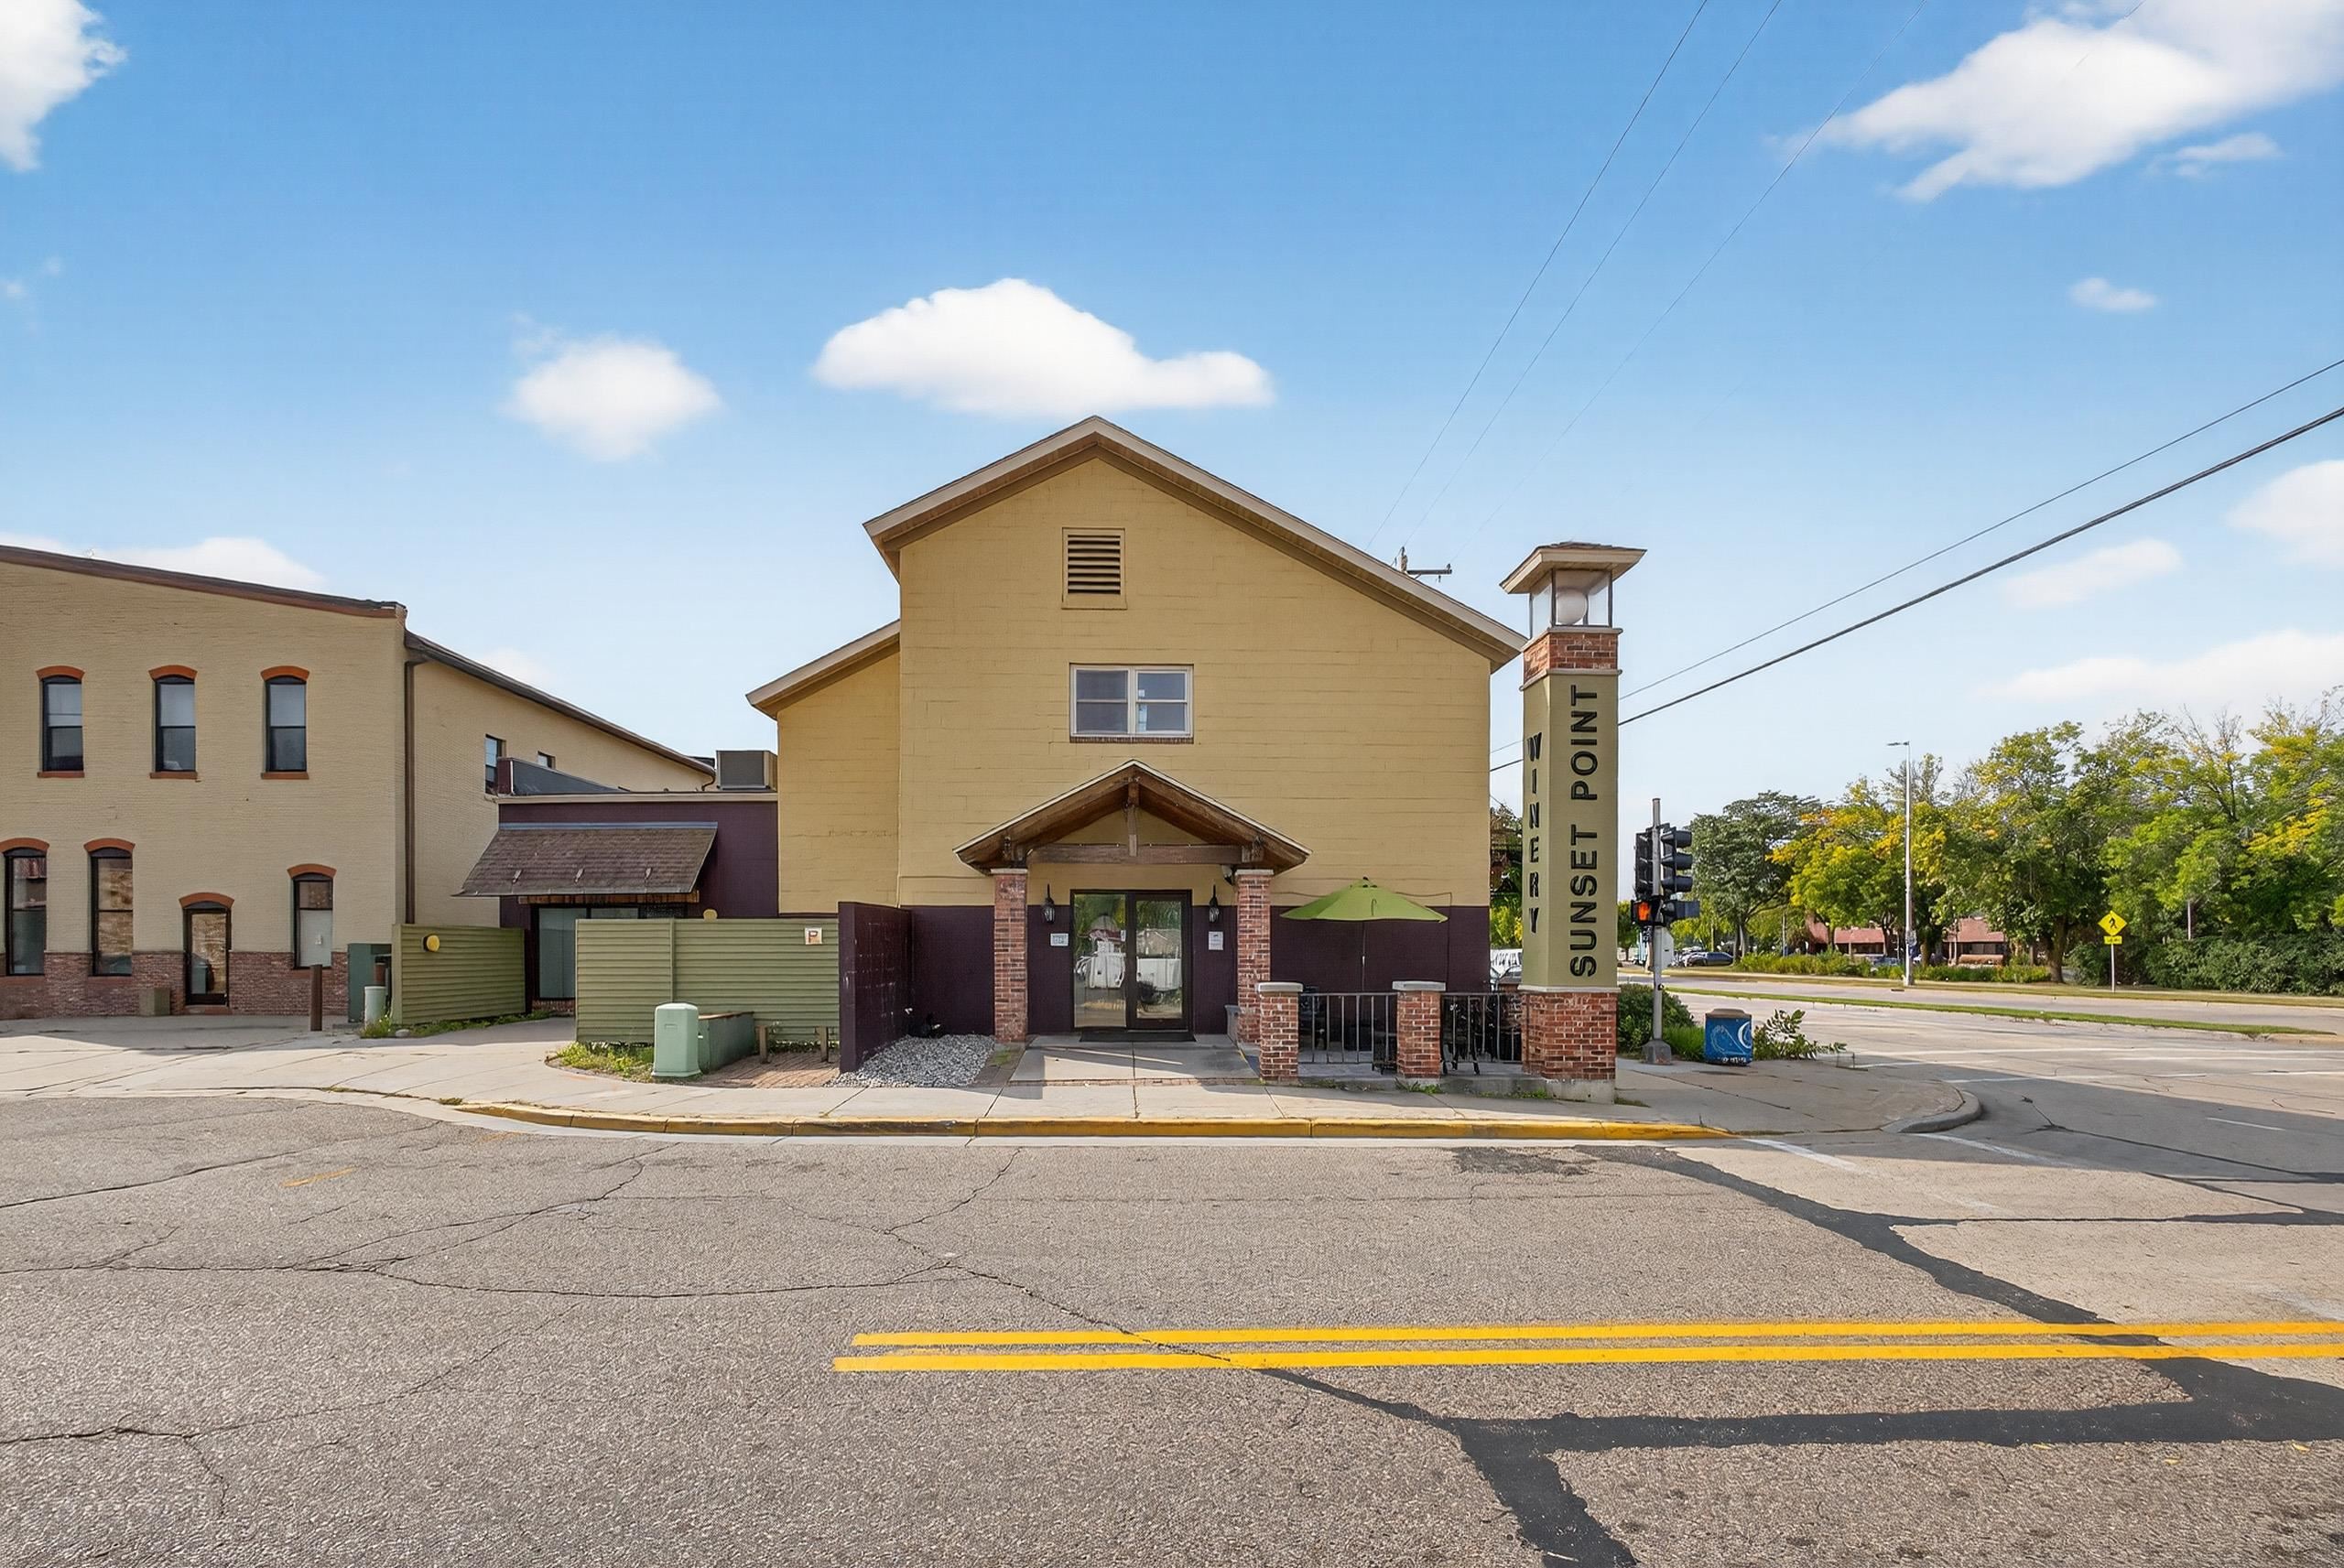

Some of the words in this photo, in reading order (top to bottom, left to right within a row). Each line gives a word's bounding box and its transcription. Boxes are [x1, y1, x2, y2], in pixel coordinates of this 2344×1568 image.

[1570, 684, 1598, 800] POINT
[1526, 731, 1543, 934] WINERY
[1569, 824, 1598, 978] SUNSET
